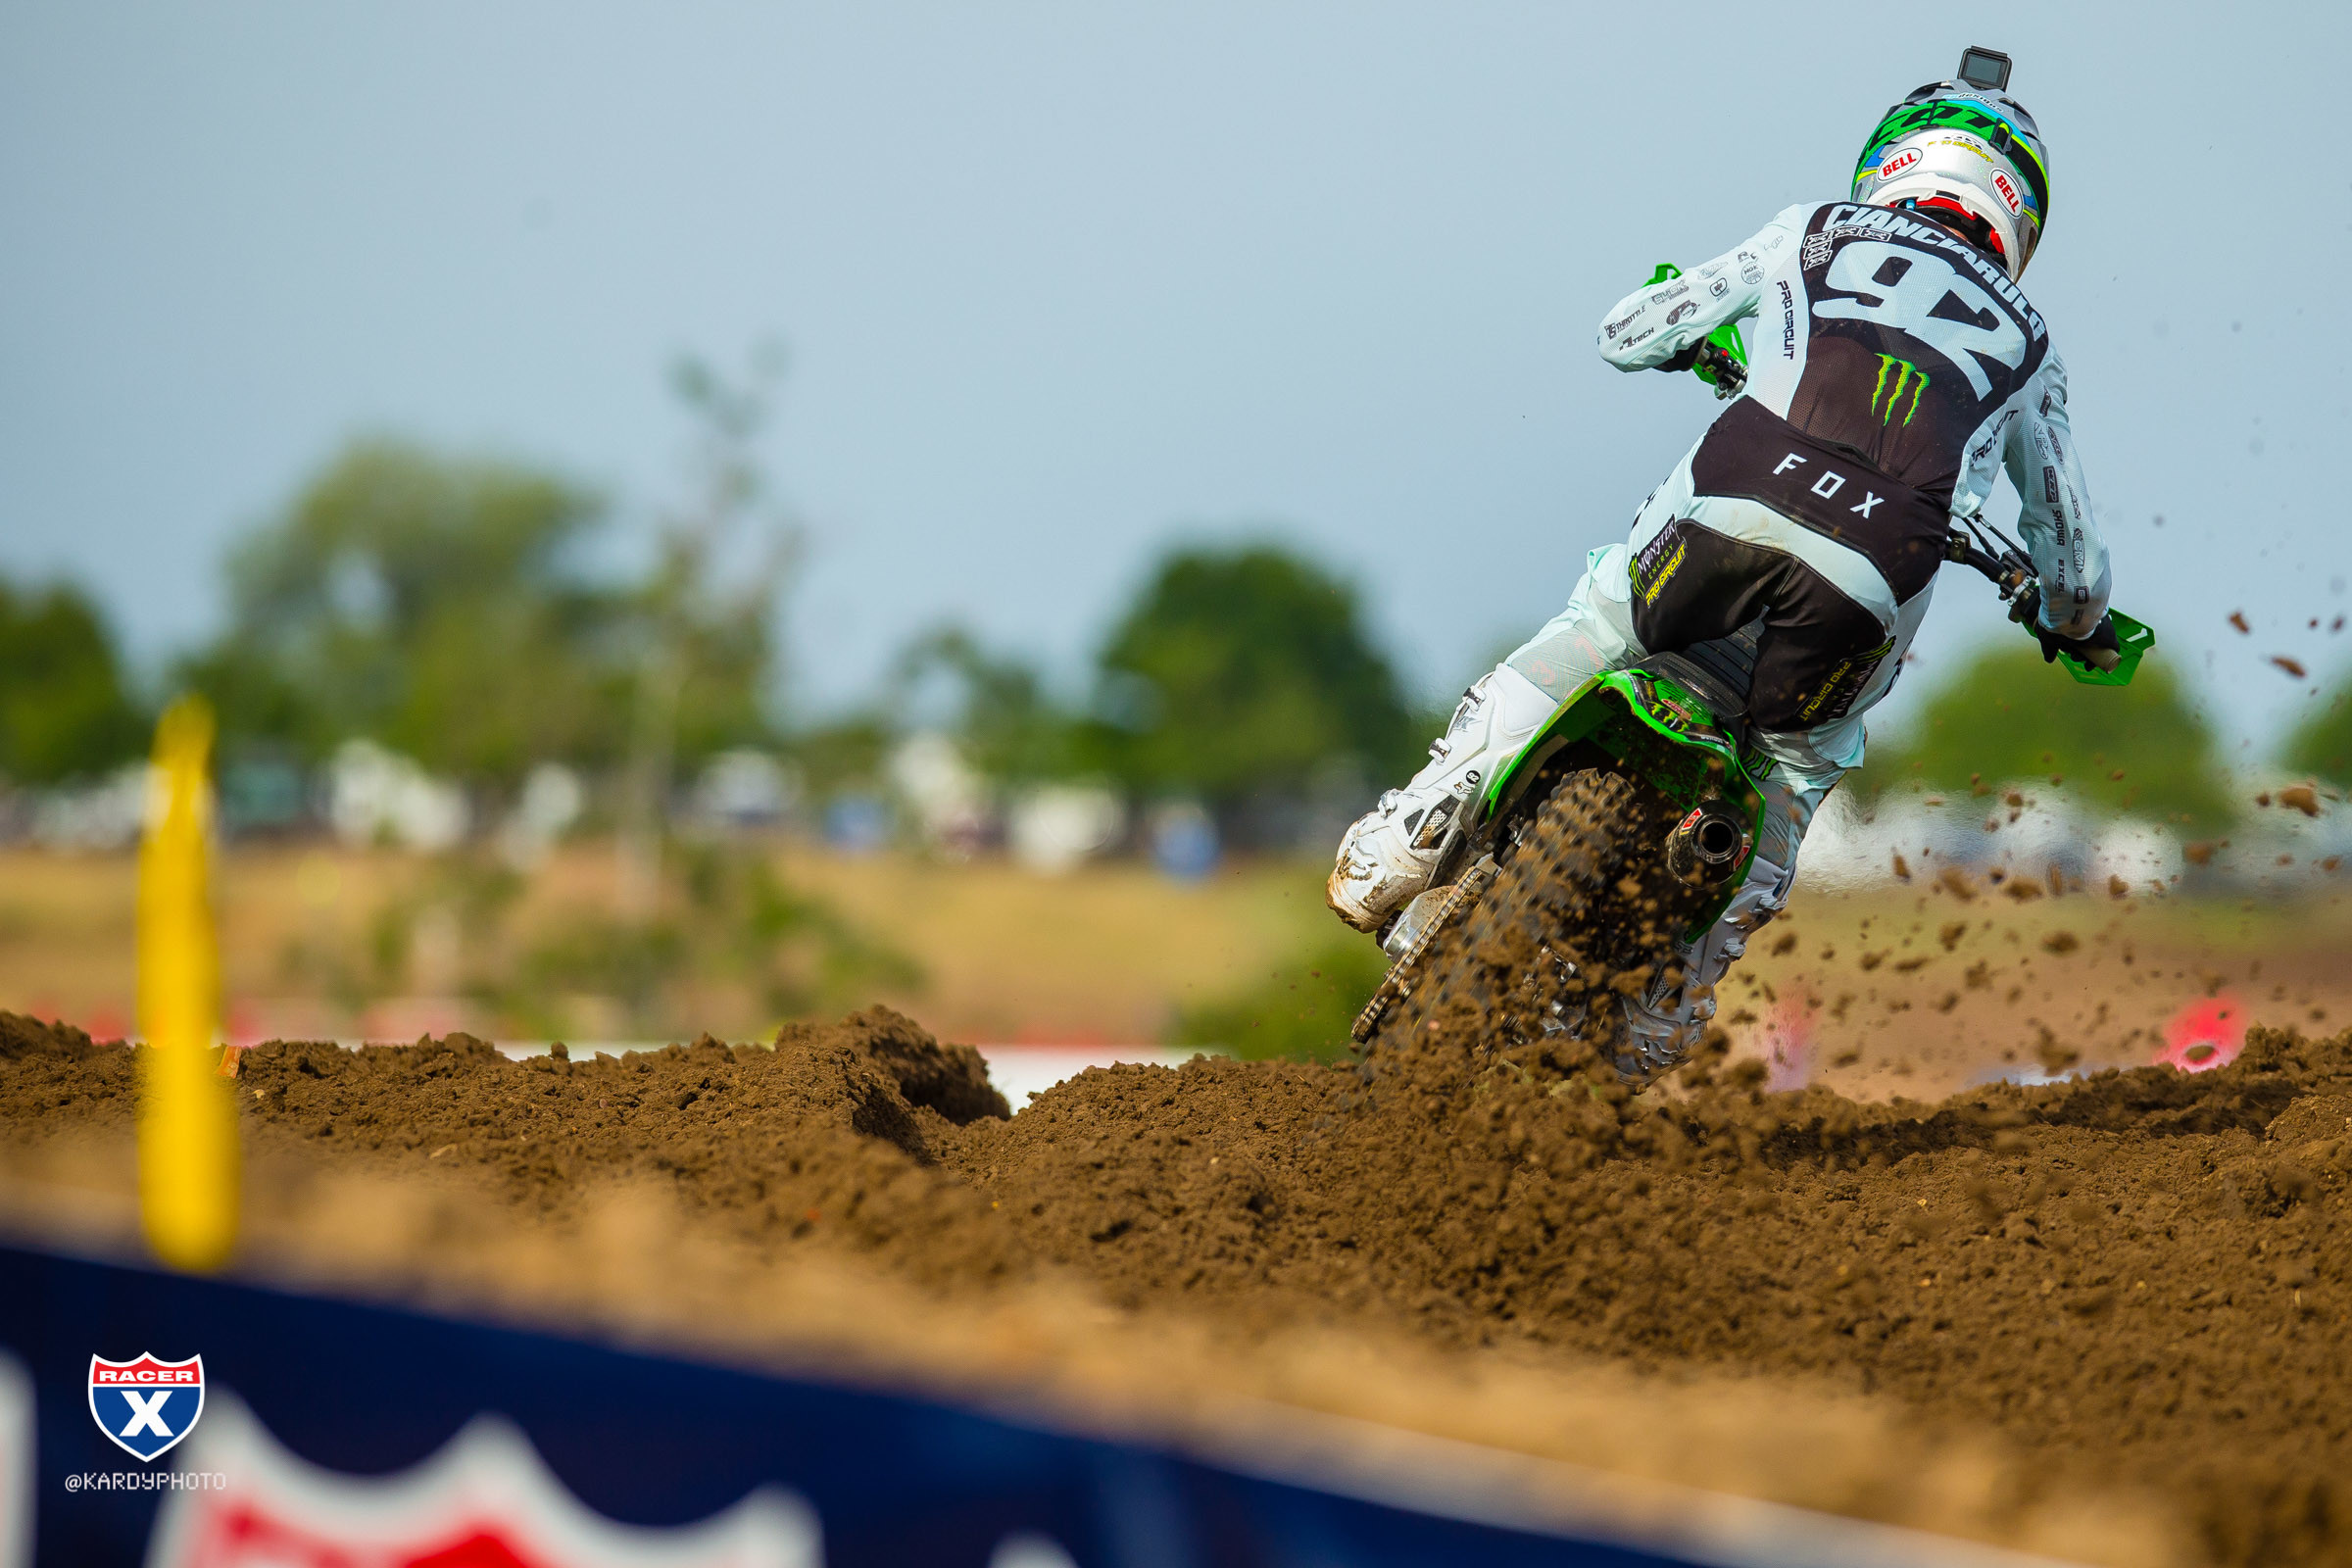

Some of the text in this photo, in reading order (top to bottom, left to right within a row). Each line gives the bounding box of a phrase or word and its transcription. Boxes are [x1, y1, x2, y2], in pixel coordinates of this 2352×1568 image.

[1882, 153, 1917, 178] BELL
[1994, 174, 2022, 214] BELL
[1822, 204, 2046, 342] CIANCIARULO
[1615, 305, 1646, 330] THROTTLE
[1776, 279, 1795, 361] PRO CIRCUIT
[1811, 240, 2028, 403] 92
[1772, 453, 1886, 520] FOX
[1638, 519, 1675, 575] MONSTER
[2052, 509, 2066, 547] SHOWA
[1645, 543, 1687, 607] PRO CIRCUIT
[1647, 543, 1674, 580] ENERGY
[1830, 662, 1852, 683] PRO
[1799, 682, 1834, 722] CIRCUIT
